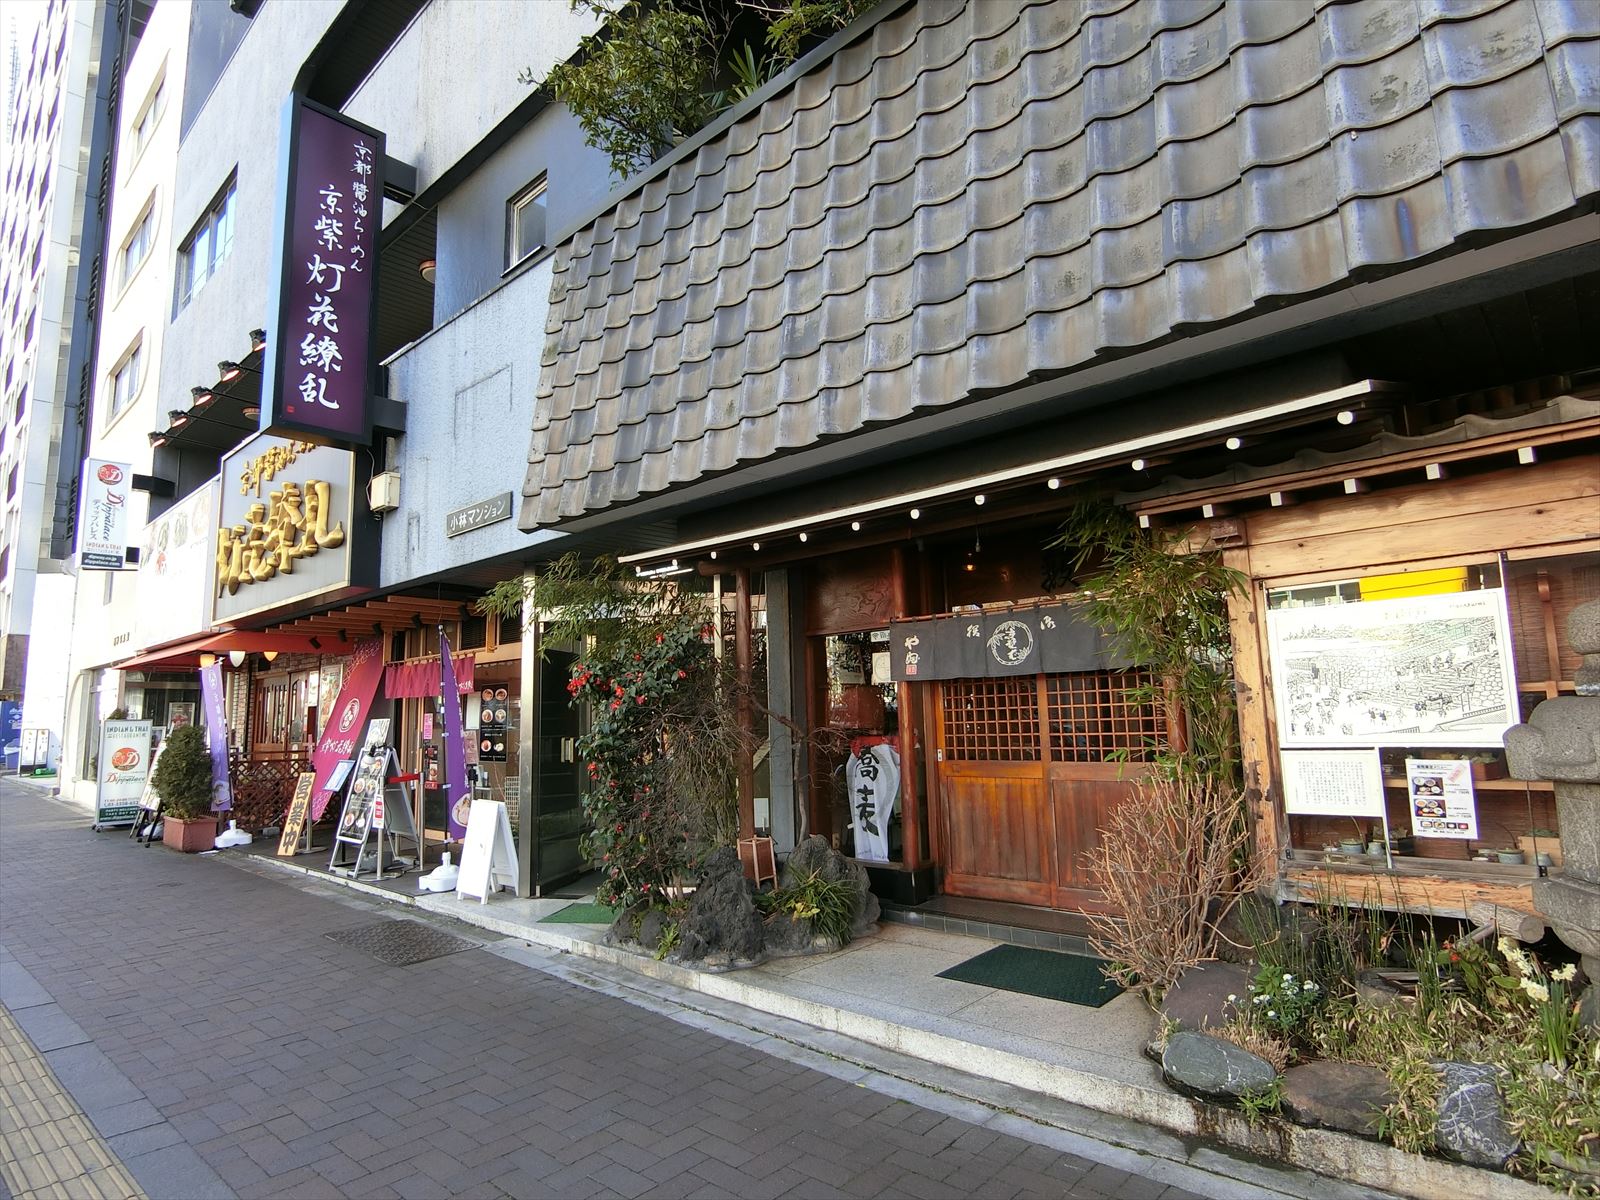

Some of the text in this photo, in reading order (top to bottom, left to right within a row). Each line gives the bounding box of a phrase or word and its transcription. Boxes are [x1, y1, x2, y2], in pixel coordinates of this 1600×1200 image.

[299, 184, 346, 410] 京紫灯花繚乱
[450, 500, 506, 531] 小林マンション
[282, 774, 313, 855] 営業中
